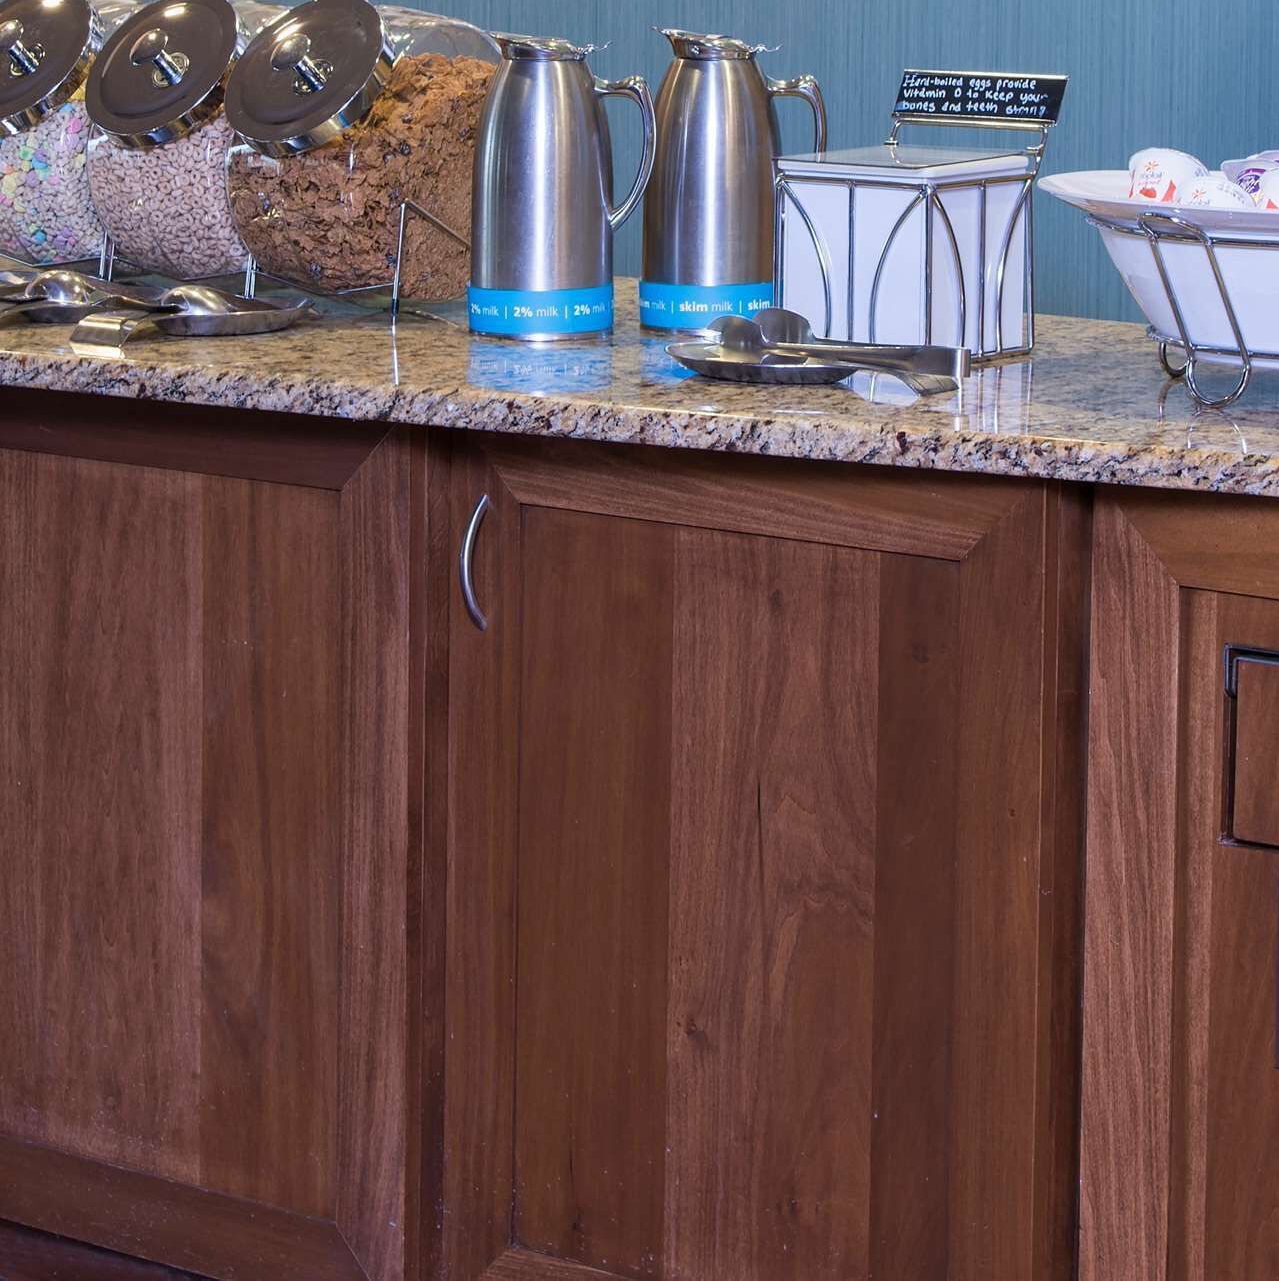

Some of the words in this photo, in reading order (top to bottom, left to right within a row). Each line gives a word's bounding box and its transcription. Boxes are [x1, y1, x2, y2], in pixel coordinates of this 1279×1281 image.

[969, 78, 991, 91] eggs
[996, 78, 1037, 90] provide
[903, 88, 946, 99] Vitamin
[967, 88, 978, 99] to
[902, 101, 936, 112] bones
[941, 102, 961, 112] and
[966, 101, 998, 114] teeth
[482, 305, 499, 317] milk
[513, 305, 533, 317] 2%
[536, 305, 558, 317] milk
[574, 304, 590, 316] 2%
[680, 301, 708, 312] skim
[711, 300, 733, 312] milk
[748, 299, 770, 311] skim
